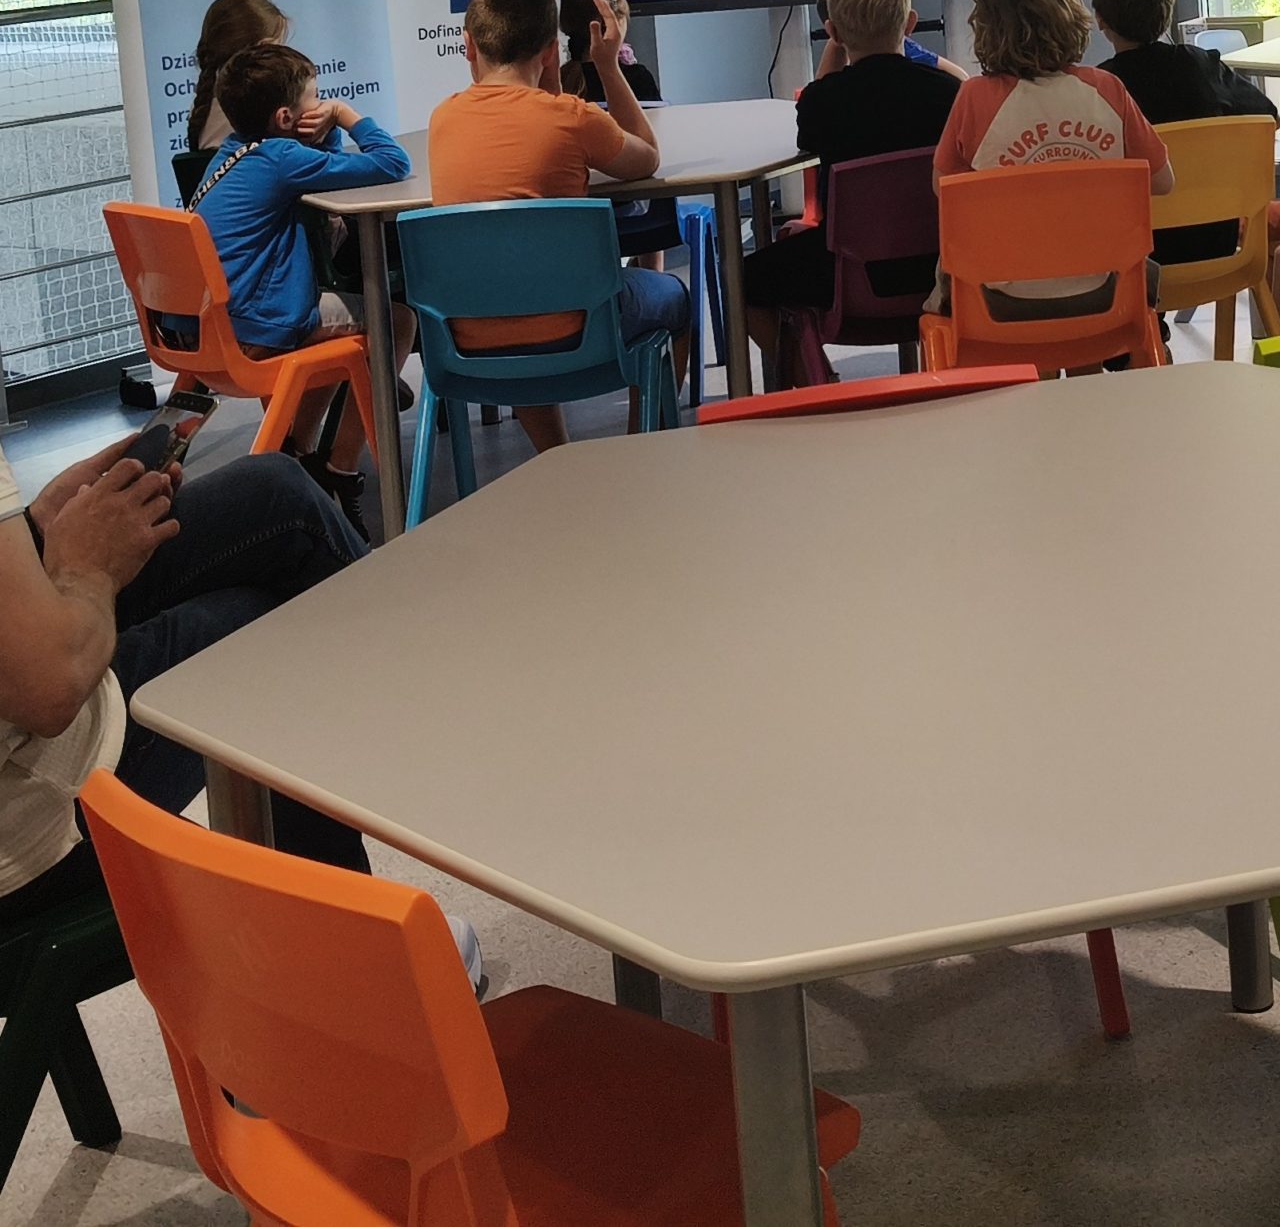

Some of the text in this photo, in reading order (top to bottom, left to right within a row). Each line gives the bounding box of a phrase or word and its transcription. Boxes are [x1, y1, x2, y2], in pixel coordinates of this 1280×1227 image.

[418, 25, 465, 40] Dofina
[162, 53, 346, 75] Dzia anie
[164, 79, 379, 100] Och zwojem
[999, 120, 1115, 166] SURF CLUB
[1033, 147, 1096, 164] SURROUN
